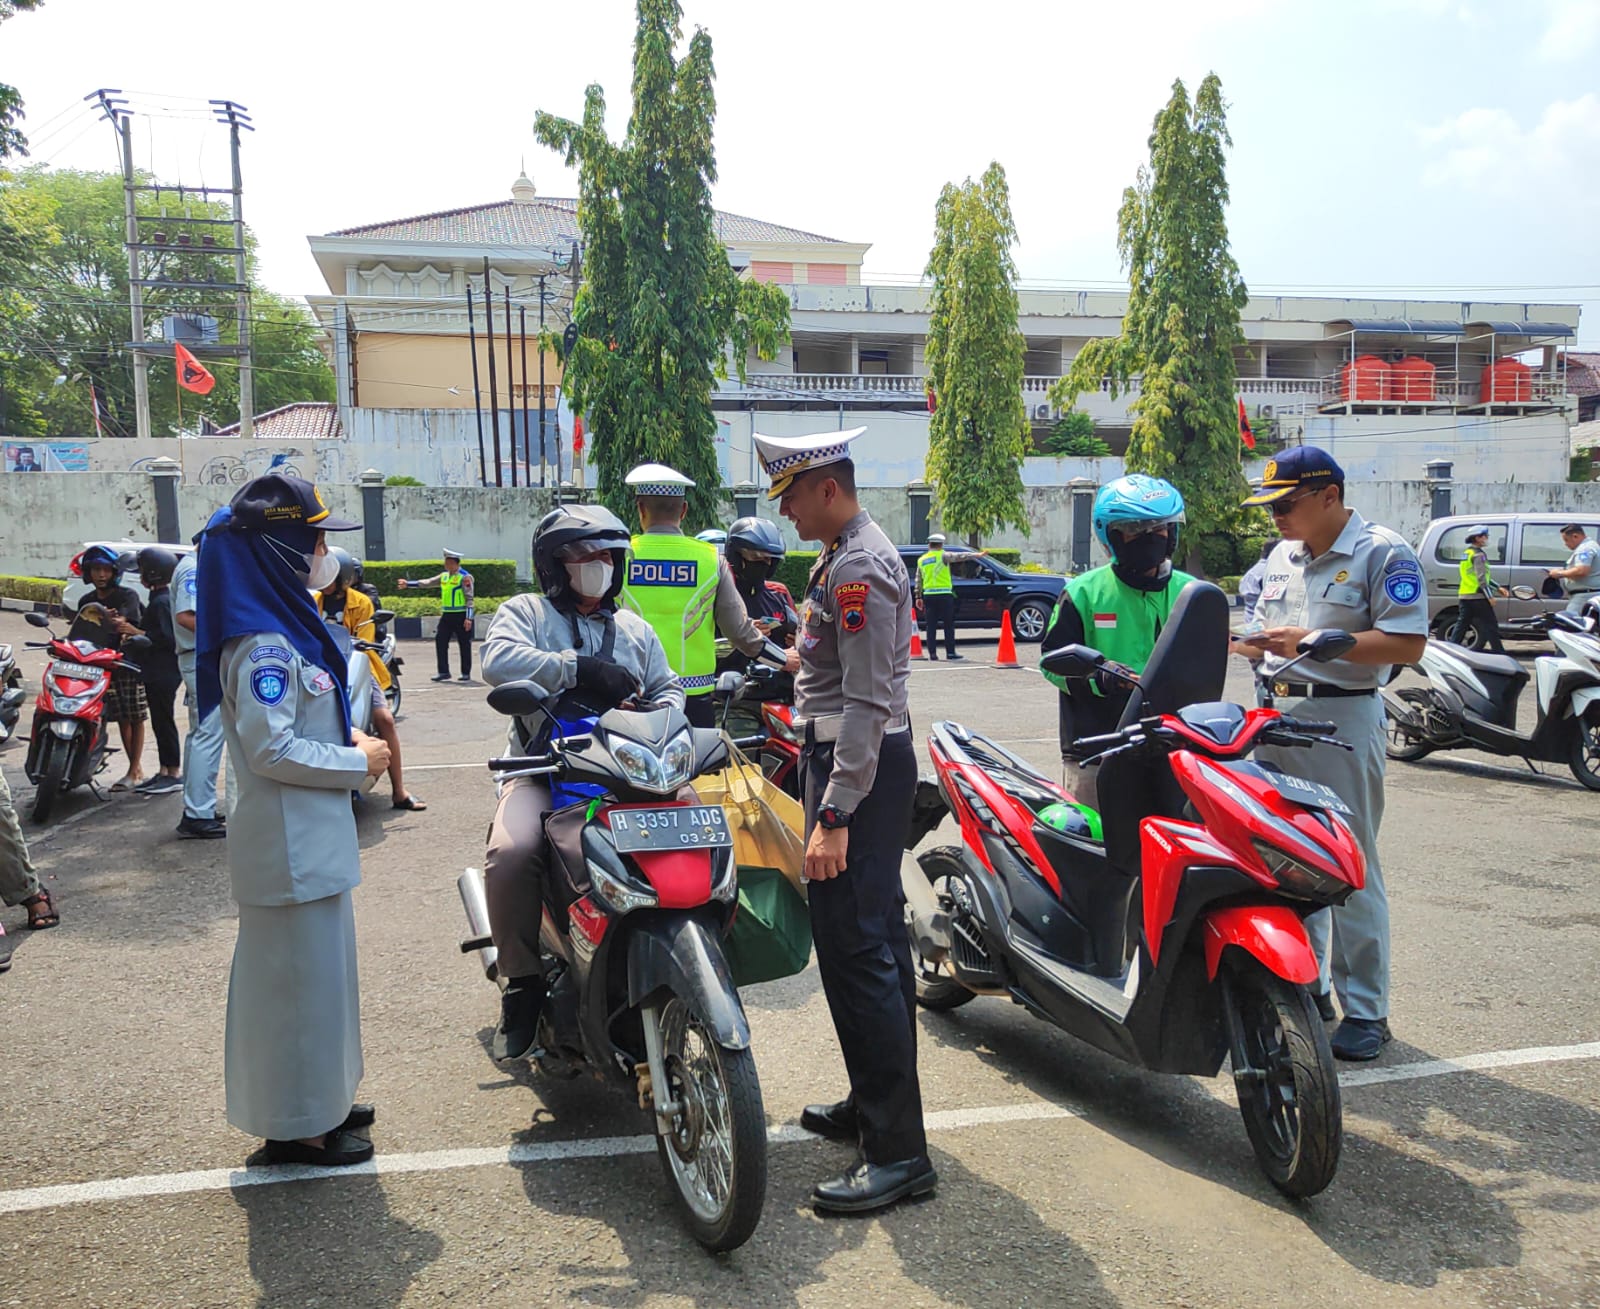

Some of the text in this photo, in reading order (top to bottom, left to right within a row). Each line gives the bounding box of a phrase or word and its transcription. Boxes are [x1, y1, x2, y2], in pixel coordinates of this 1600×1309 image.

[630, 564, 695, 582] POLISI
[837, 584, 866, 594] POLDA
[614, 809, 722, 830] H 3357 ADG
[1144, 823, 1172, 855] HONDA
